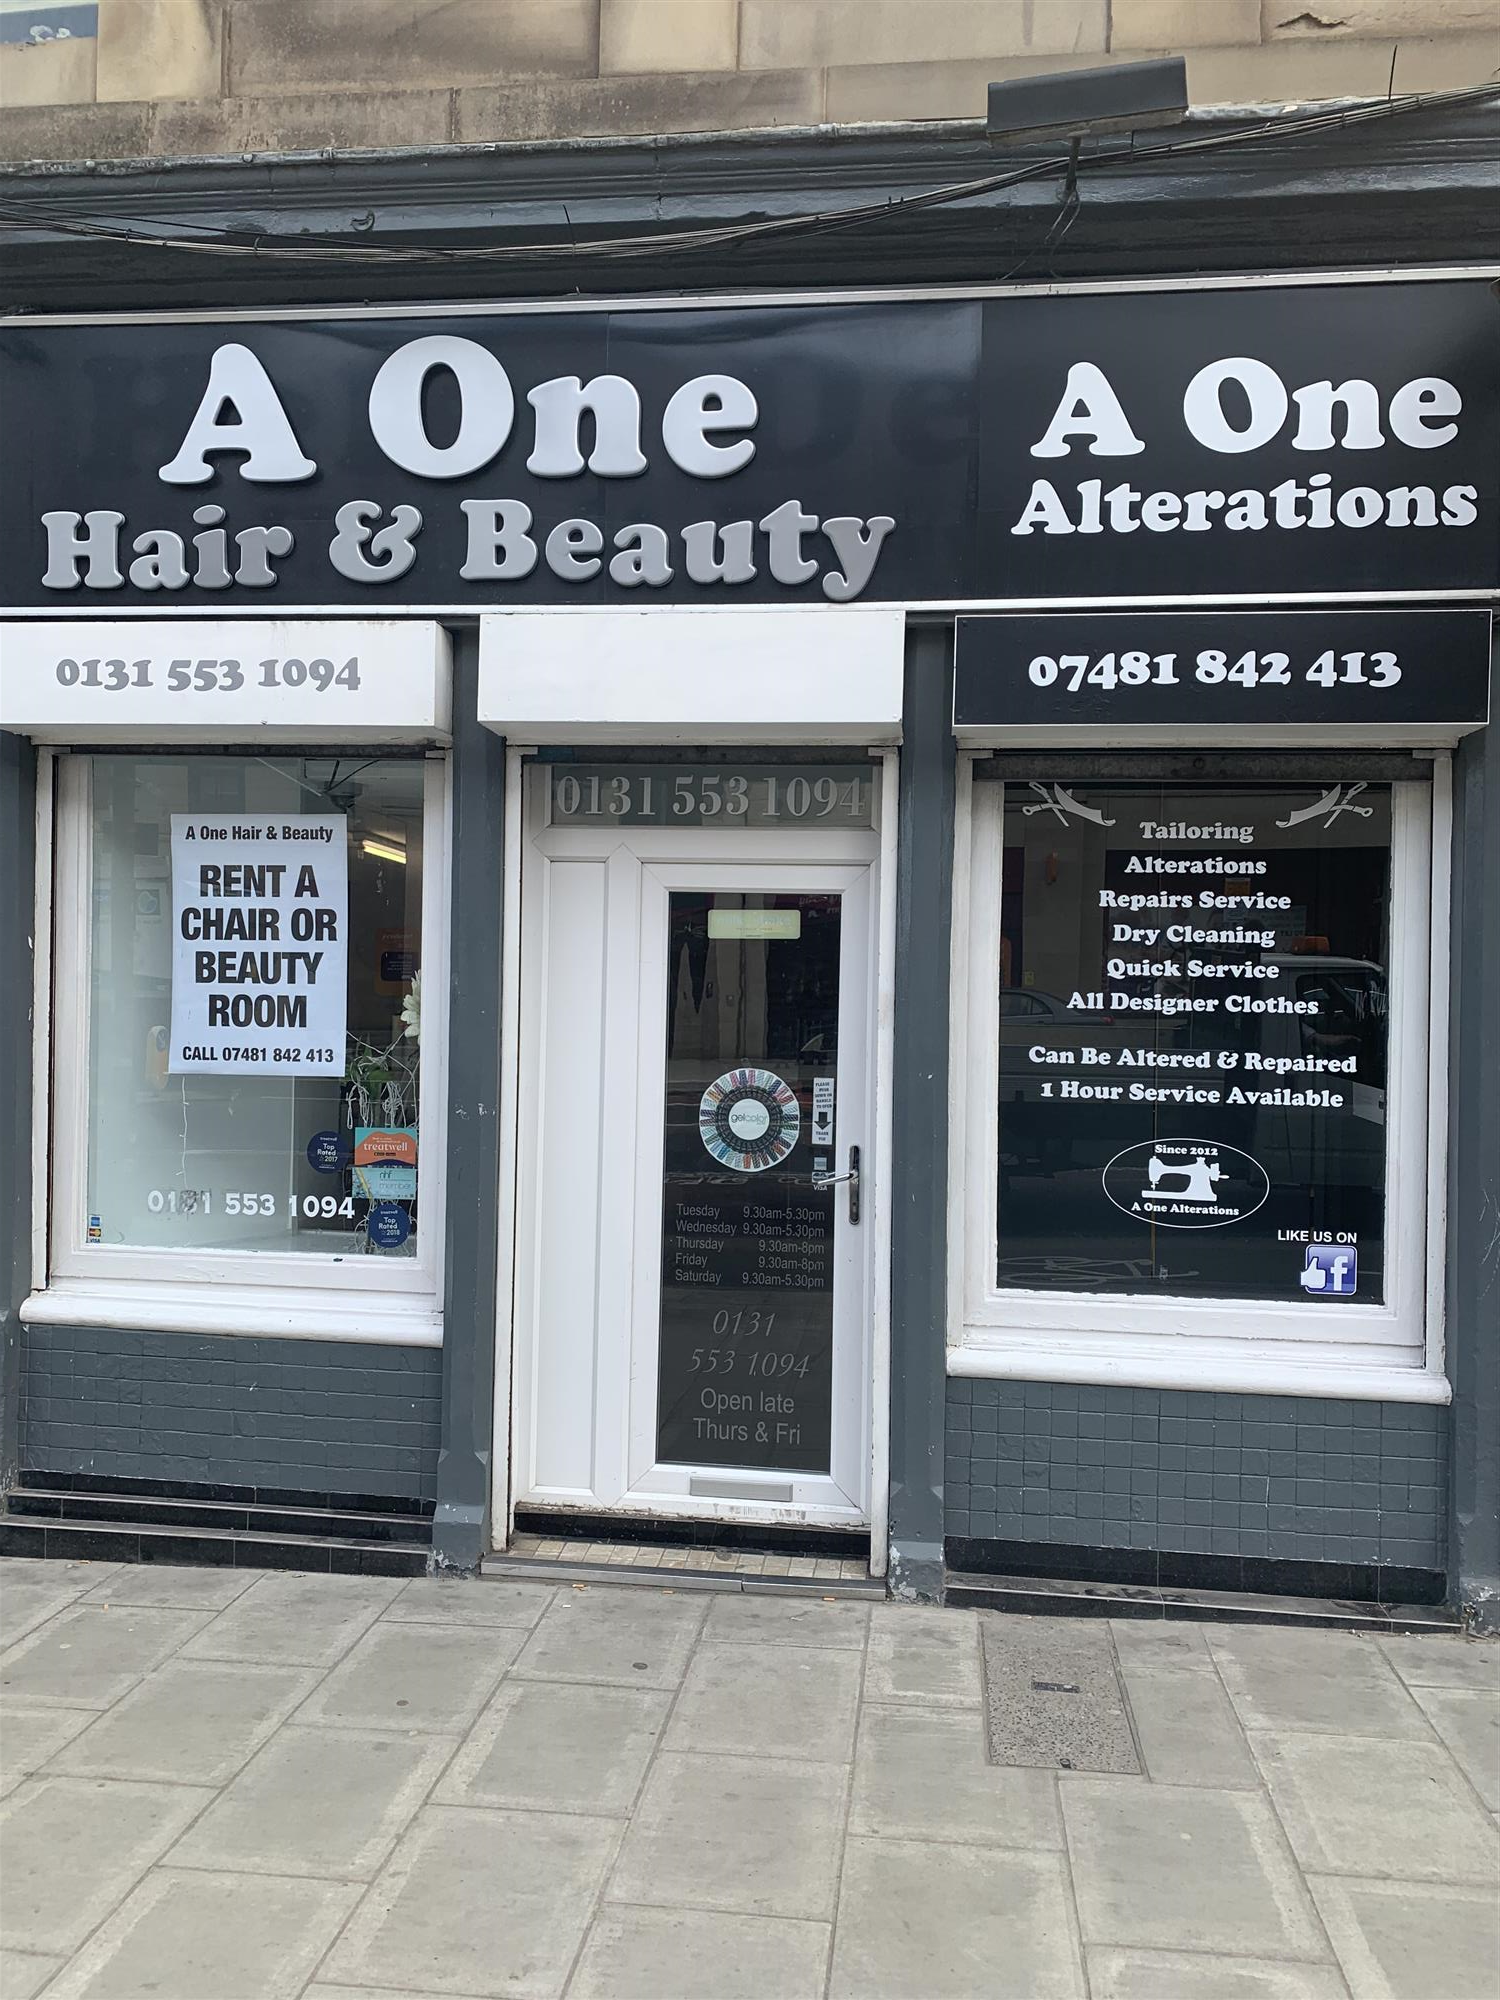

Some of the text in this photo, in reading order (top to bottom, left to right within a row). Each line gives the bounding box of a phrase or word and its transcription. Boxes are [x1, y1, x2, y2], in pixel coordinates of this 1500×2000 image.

[158, 334, 759, 484] A One
[1030, 357, 1463, 457] A One
[1011, 473, 1478, 535] Alterations
[40, 498, 896, 602] Hair & Beauty
[56, 656, 361, 692] 0131 553 1094
[1028, 650, 1402, 692] 07481 842 413
[557, 775, 865, 816] 0131 553 1094
[185, 825, 333, 842] A One Hair & Beauty
[1139, 822, 1254, 843] Tailoring
[1124, 857, 1267, 874] Alterations
[200, 864, 319, 897] RENT A
[1098, 890, 1291, 910] Repairs Service
[181, 908, 337, 941] CHAIR OR
[1112, 926, 1276, 947] Dry Cleaning
[195, 951, 323, 983] BEAUTY
[1107, 959, 1280, 979] Quick Service
[208, 994, 307, 1026] ROOM
[1066, 993, 1319, 1015] All Designer Clothes
[182, 1045, 334, 1062] CALL 07481 842 413
[1029, 1046, 1357, 1074] Can Be Altered & Repaired
[1041, 1082, 1344, 1108] 1 Hour Service Available
[323, 1143, 335, 1151] Top
[363, 1142, 408, 1152] treatwell
[1155, 1144, 1218, 1156] Since 2012
[225, 1193, 275, 1216] 553
[288, 1195, 355, 1218] 1094
[676, 1204, 825, 1222] Tuesday 9.30am-5.30pm
[1131, 1202, 1239, 1215] A One Alterations
[676, 1220, 825, 1238] Wednesday 9.30am-5.30pm
[1278, 1230, 1357, 1243] LIKE US ON
[676, 1237, 825, 1254] Thursday 9.30am-8pm
[676, 1253, 824, 1271] Friday 9.30am-8pm
[675, 1270, 824, 1288] Saturday 9.30am-5.30pm
[713, 1310, 776, 1336] 0131
[686, 1349, 810, 1378] 553 1094
[701, 1388, 794, 1414] Open late
[693, 1417, 800, 1444] Thurs & Fri
